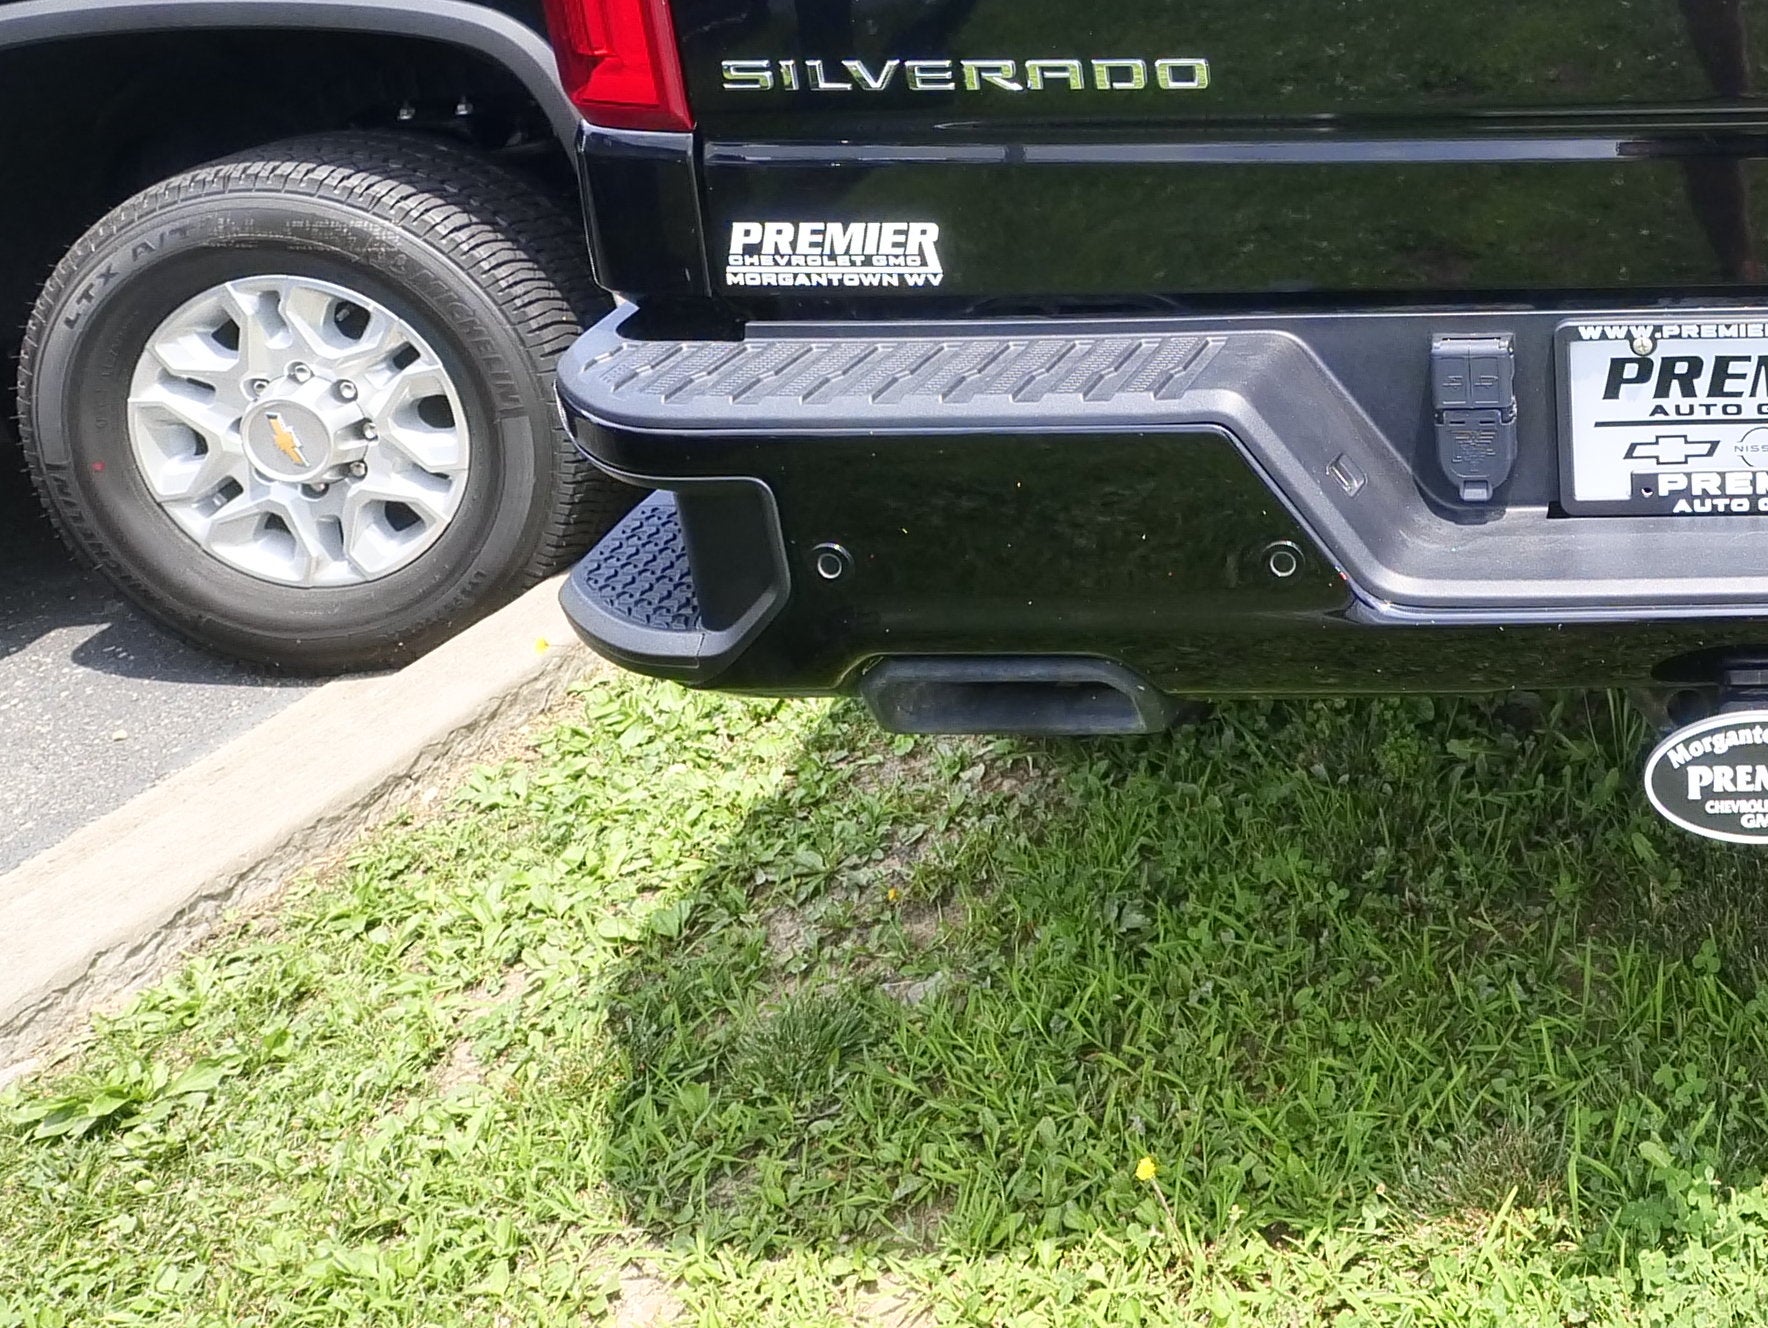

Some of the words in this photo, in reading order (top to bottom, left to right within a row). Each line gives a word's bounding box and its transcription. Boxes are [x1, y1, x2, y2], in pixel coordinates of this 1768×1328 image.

[720, 59, 1211, 91] SILVERADO
[729, 222, 942, 268] PREMIER
[726, 273, 899, 287] MORGANTOWN
[904, 273, 944, 287] WV
[1648, 402, 1743, 417] AUTO
[1672, 497, 1751, 514] AUTO
